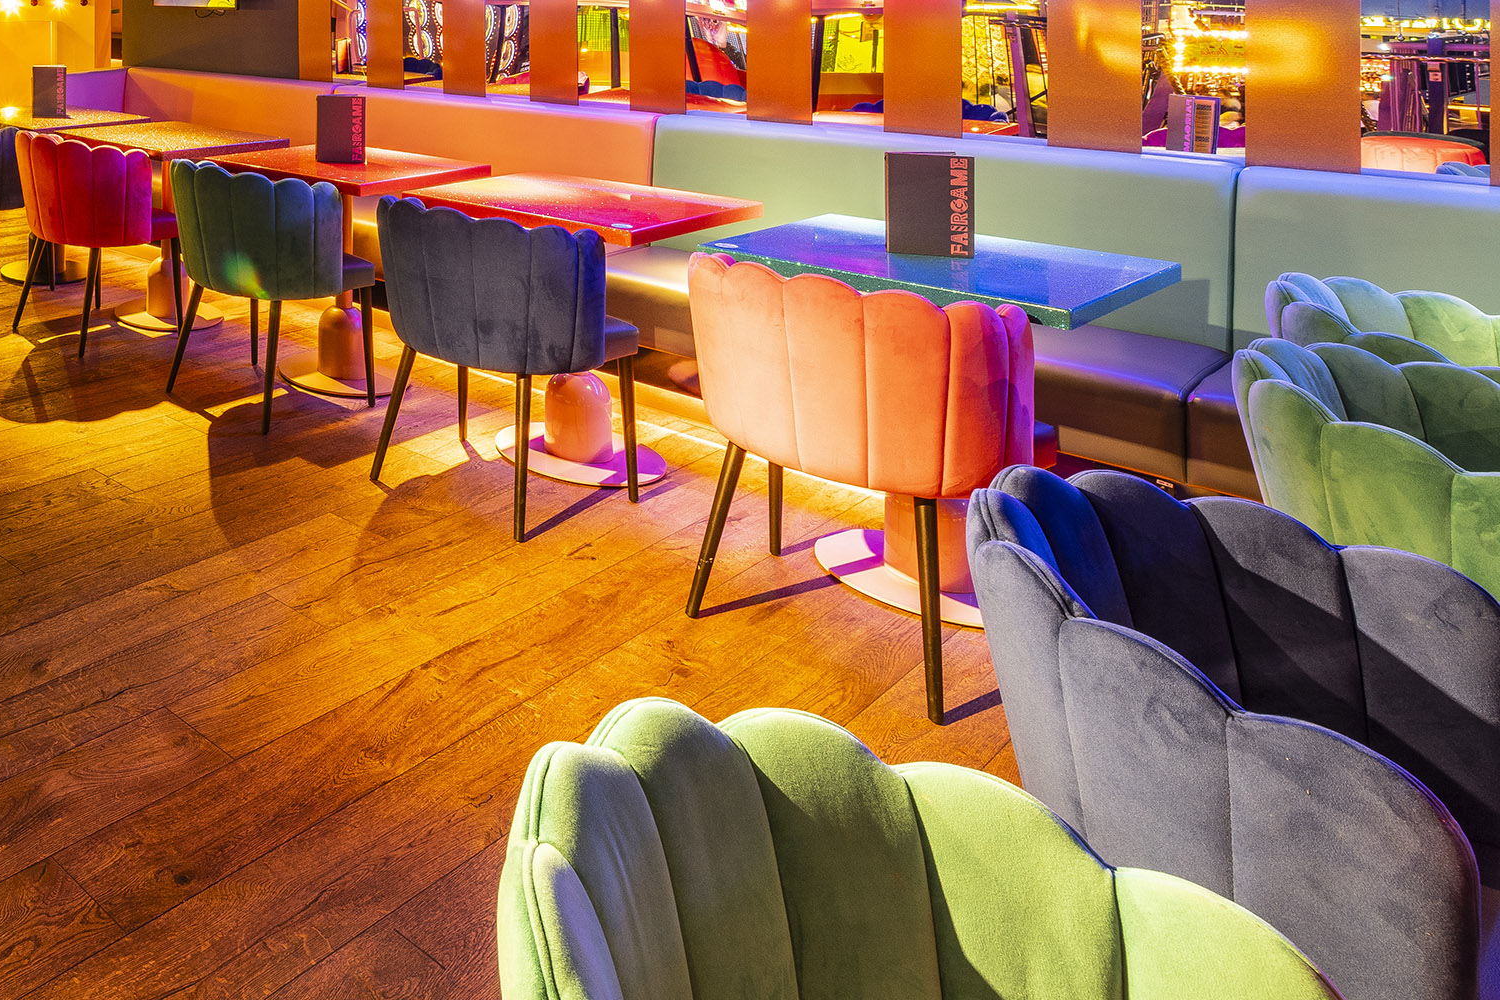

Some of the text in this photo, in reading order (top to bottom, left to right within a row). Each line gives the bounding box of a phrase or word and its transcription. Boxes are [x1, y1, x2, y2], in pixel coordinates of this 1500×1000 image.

[56, 67, 64, 114] FAIRGAME
[351, 97, 363, 161] FAIRGAME
[950, 157, 969, 256] FAIRGAME
